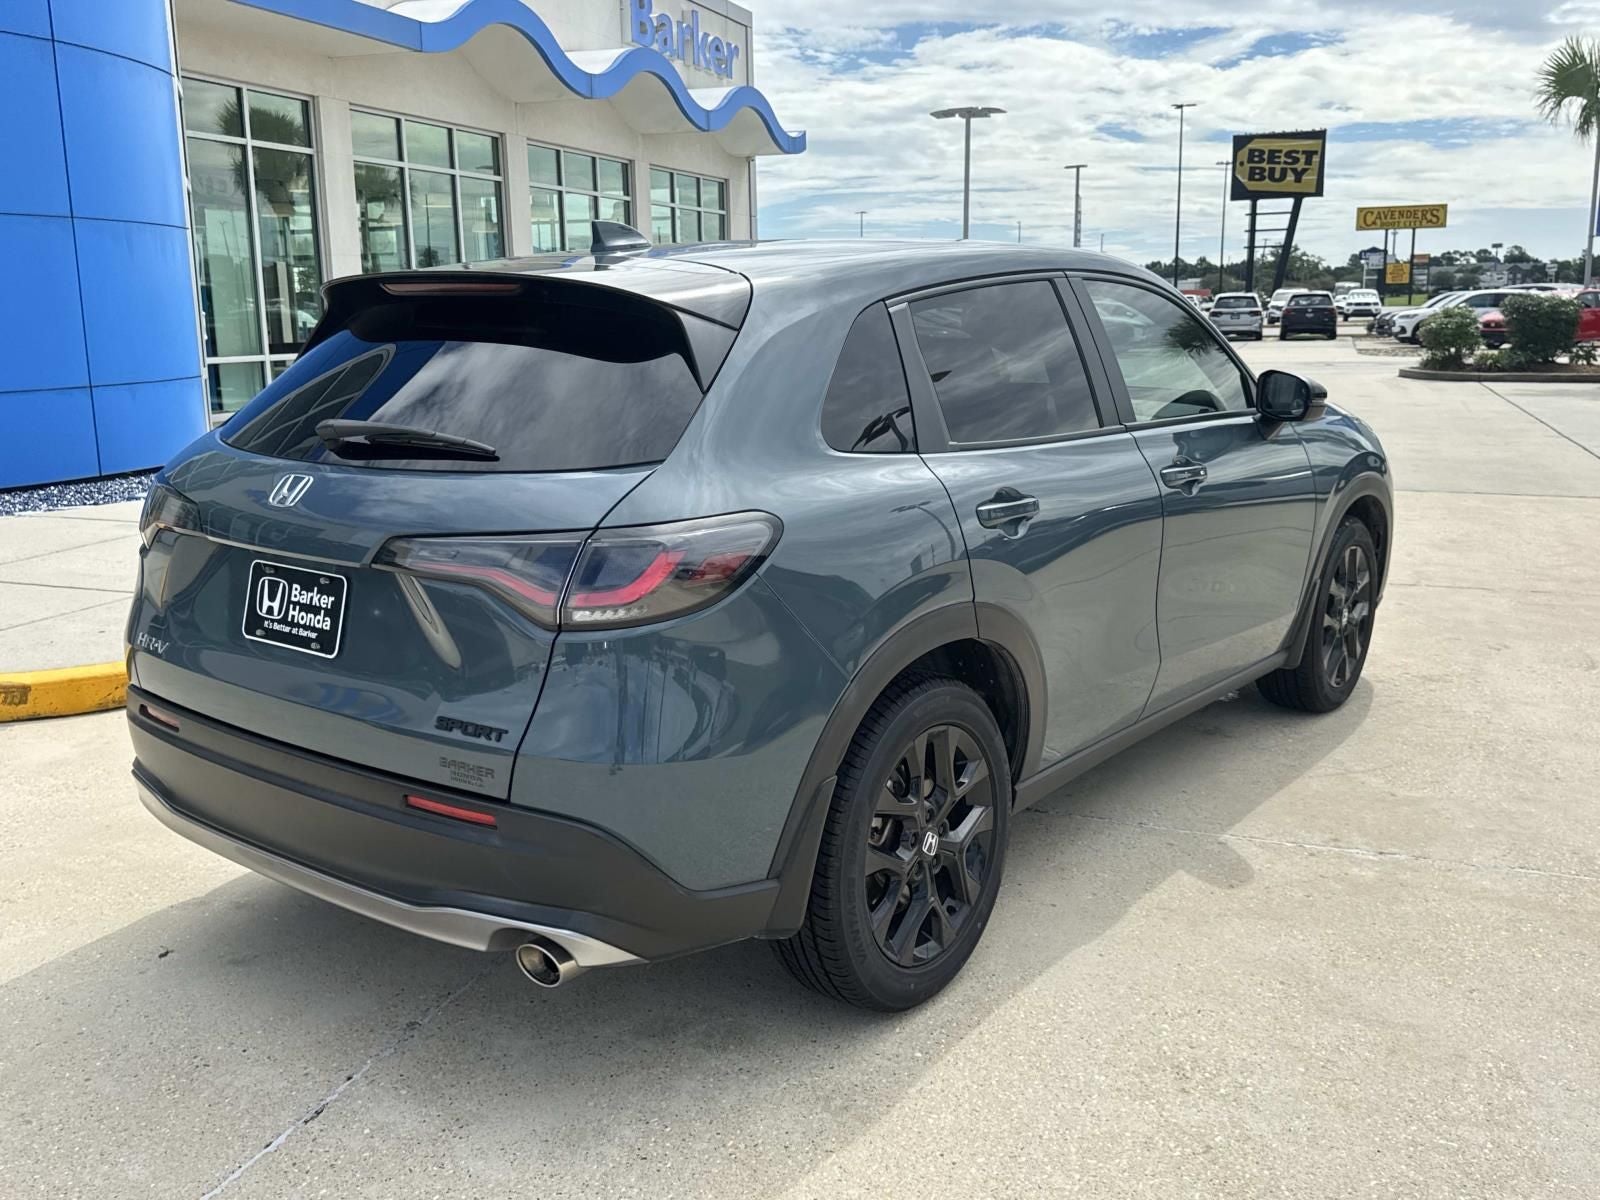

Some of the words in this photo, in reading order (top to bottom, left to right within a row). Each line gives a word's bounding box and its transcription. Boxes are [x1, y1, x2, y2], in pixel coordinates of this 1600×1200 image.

[630, 0, 740, 80] Barker
[1246, 148, 1319, 166] BEST
[1247, 166, 1312, 183] BUY
[1363, 208, 1440, 227] CAVENDER'S
[290, 583, 335, 609] Barker
[287, 603, 331, 631] Honda
[263, 619, 273, 629] It's
[273, 622, 291, 633] Better
[291, 627, 298, 635] at
[298, 628, 318, 639] Barker
[434, 715, 509, 743] SPORT
[439, 756, 495, 779] BARKER
